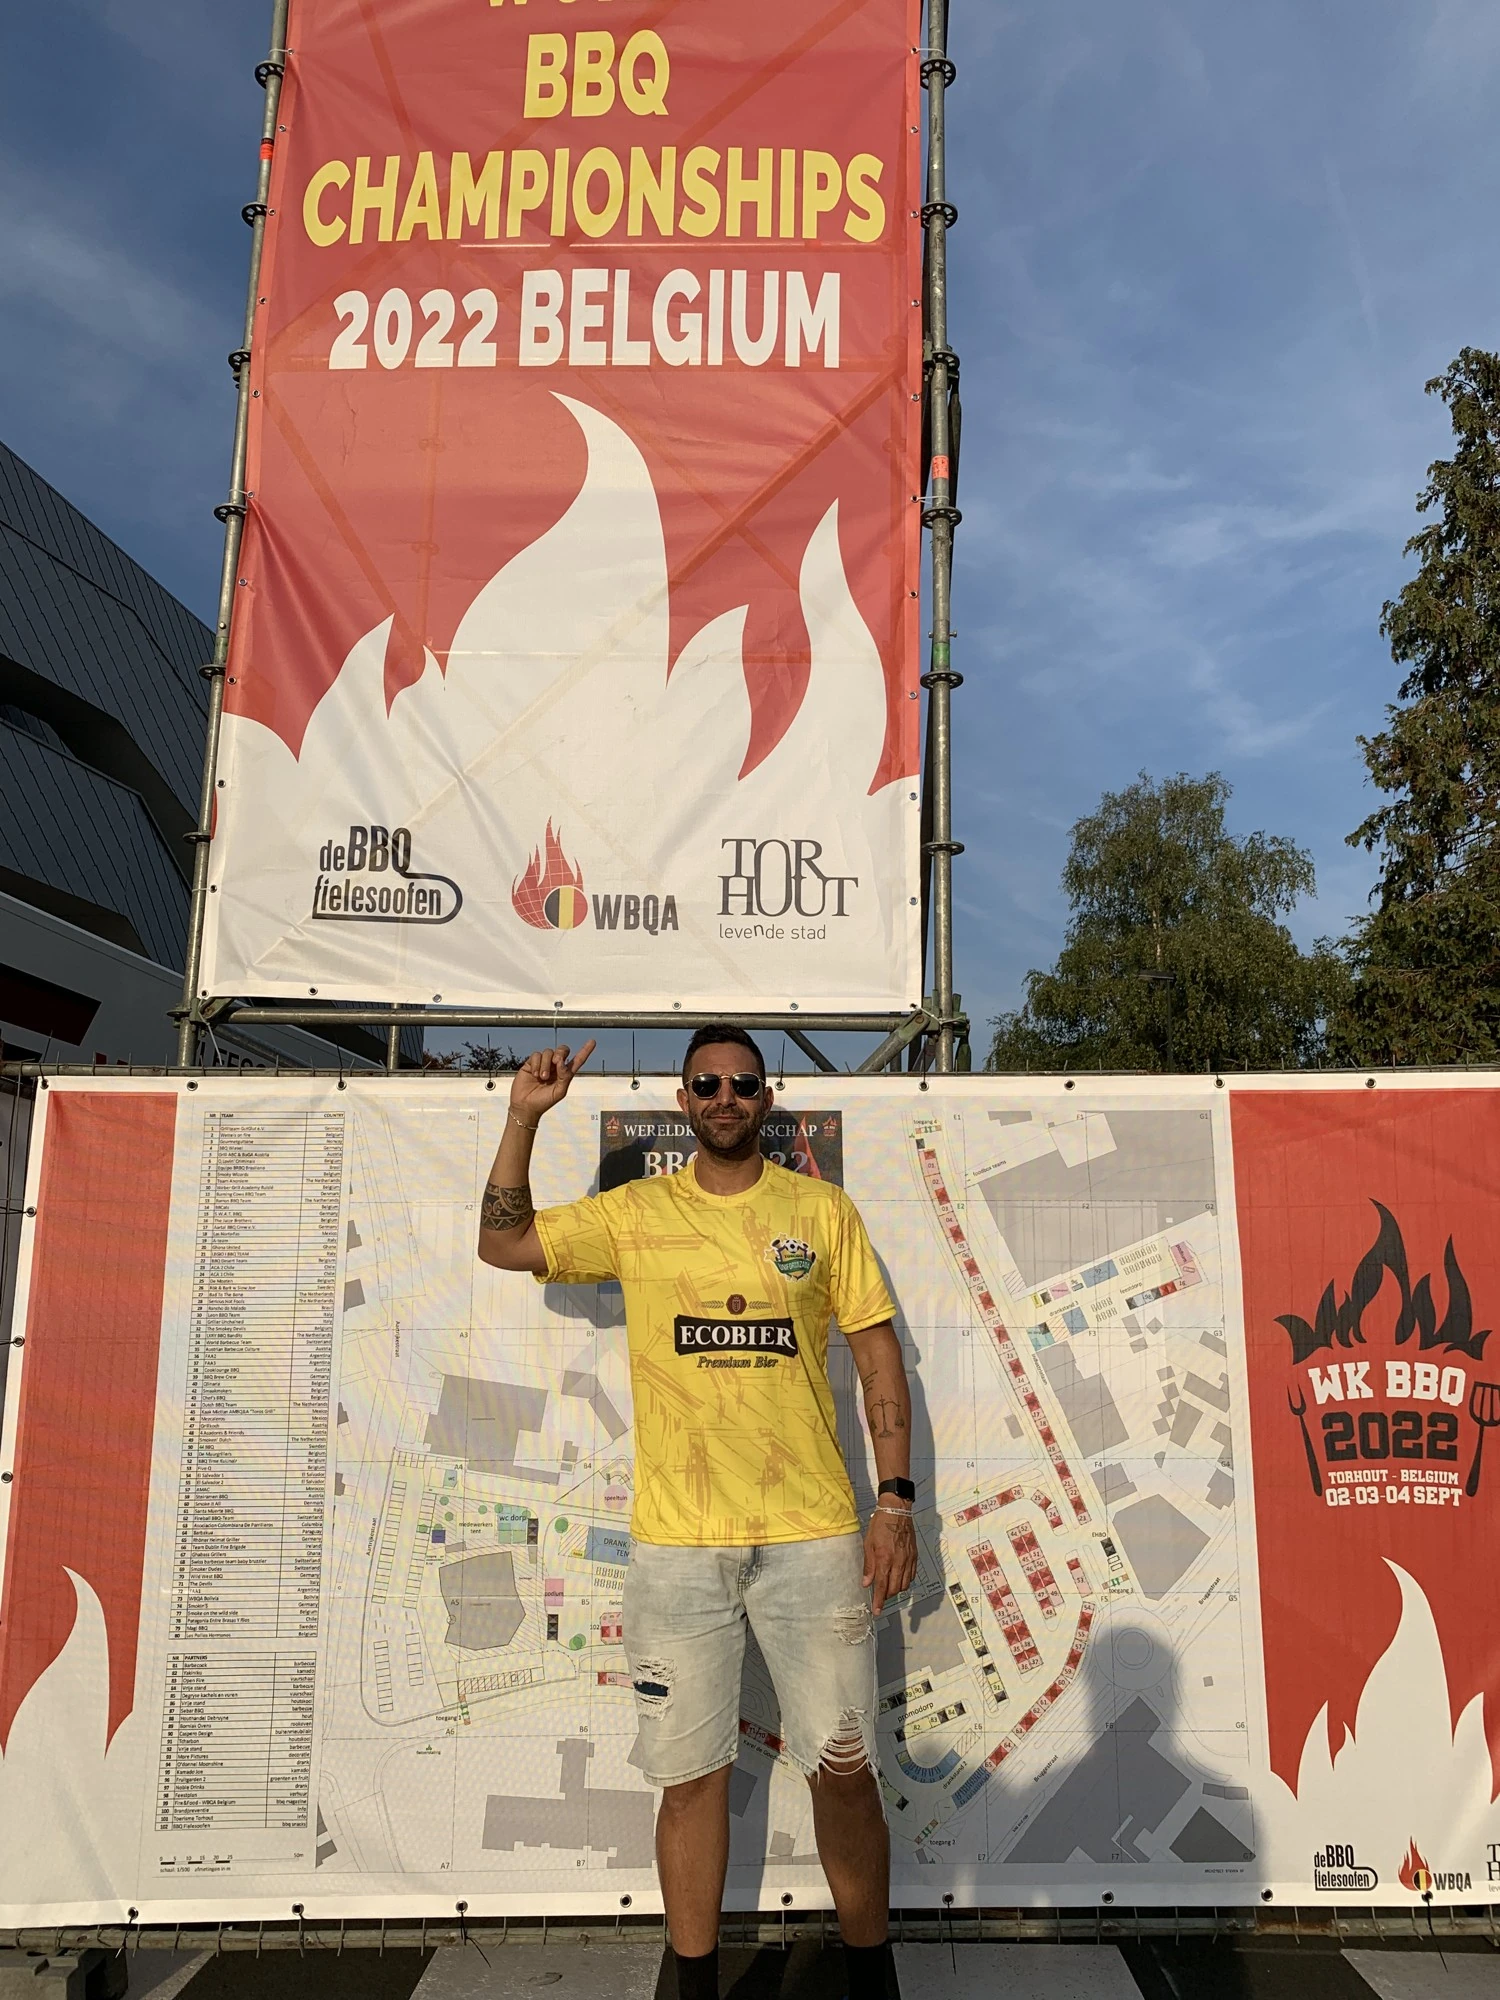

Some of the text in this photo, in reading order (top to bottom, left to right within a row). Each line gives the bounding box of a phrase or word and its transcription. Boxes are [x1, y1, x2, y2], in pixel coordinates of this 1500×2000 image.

[523, 29, 670, 119] BBQ
[303, 146, 886, 247] CHAMPIONSHIPS
[328, 268, 841, 371] 2022 BELGIUM
[592, 894, 679, 935] WBQA
[719, 921, 826, 940] levende stad
[1199, 1112, 1209, 1120] G1
[624, 1124, 818, 1138] WERELDKNSCHAP
[680, 1325, 796, 1350] ECOBIER
[1213, 1330, 1223, 1338] G3
[697, 1355, 779, 1369] Premium Bier
[1308, 1361, 1466, 1407] WK BBQ
[1322, 1410, 1459, 1462] 2022
[1328, 1470, 1388, 1485] TORHOUT
[1400, 1470, 1459, 1485] BELGIUM
[604, 1494, 628, 1502] speeltuin
[1413, 1486, 1463, 1507] SEPT
[510, 1514, 528, 1522] dorp
[604, 1538, 628, 1548] DRANK
[898, 1702, 934, 1722] promodorp
[1235, 1722, 1246, 1730] G6
[1033, 1755, 1058, 1783] Bruggestraat
[576, 1859, 586, 1867] B7
[1433, 1872, 1472, 1892] WBQA
